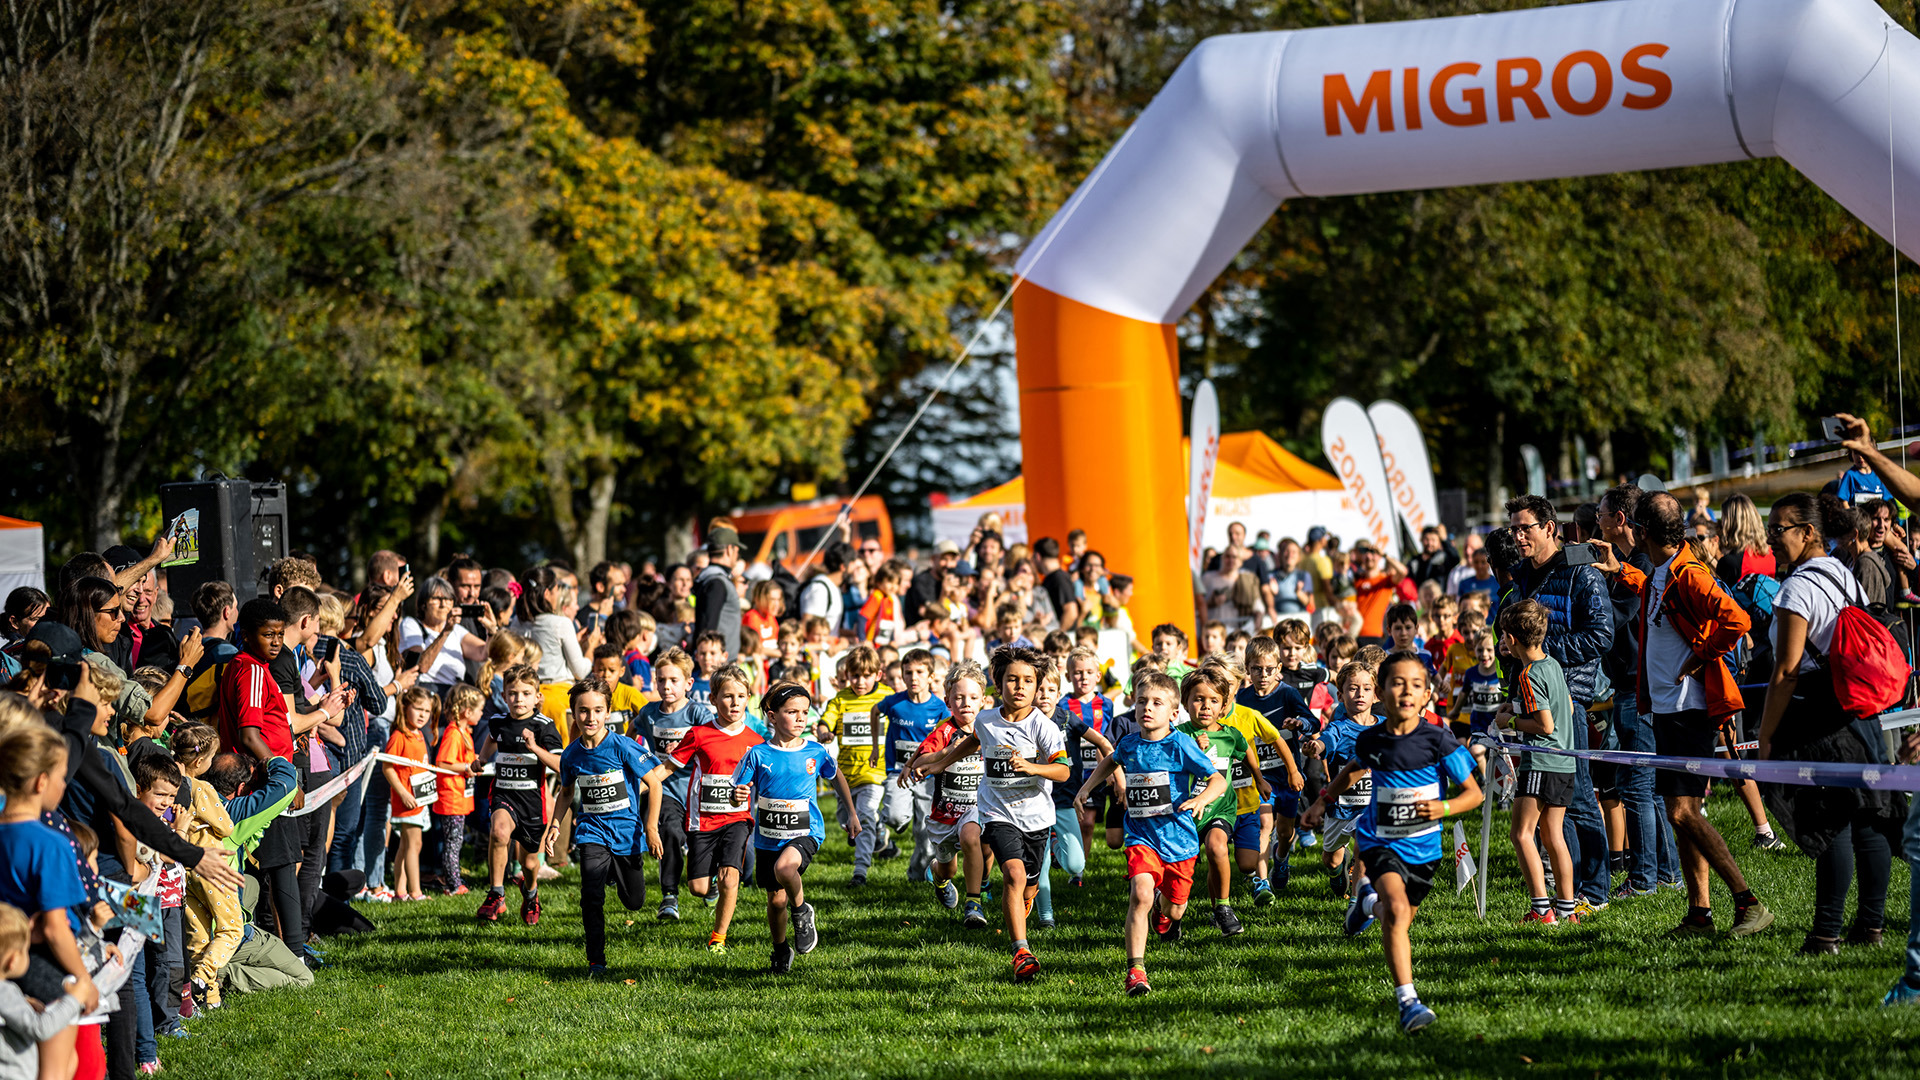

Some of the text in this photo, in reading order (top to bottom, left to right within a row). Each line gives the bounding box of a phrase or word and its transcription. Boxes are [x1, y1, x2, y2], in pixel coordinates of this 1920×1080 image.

[1322, 43, 1673, 136] MIGROS
[1477, 693, 1499, 702] 4121
[851, 725, 872, 734] 502
[1257, 745, 1277, 756] 412
[1733, 742, 1758, 750] MIG
[1080, 749, 1097, 758] 168
[500, 767, 528, 778] 5013
[993, 762, 1014, 772] 41
[587, 786, 617, 799] 4228
[710, 788, 734, 799] 426
[1128, 788, 1160, 801] 4134
[1387, 805, 1417, 820] 427
[765, 812, 799, 825] 4112
[763, 830, 782, 838] MIGROS
